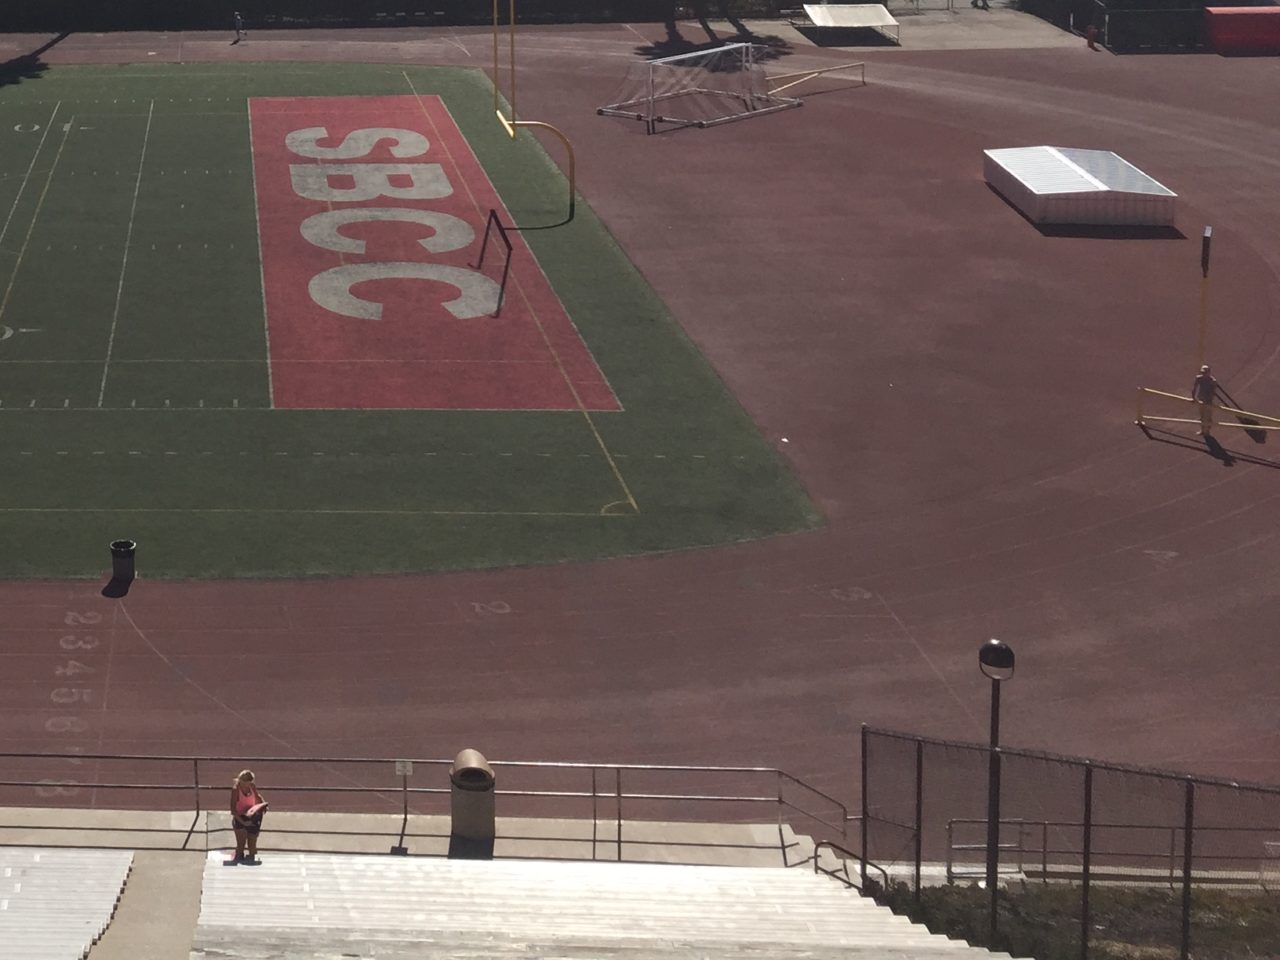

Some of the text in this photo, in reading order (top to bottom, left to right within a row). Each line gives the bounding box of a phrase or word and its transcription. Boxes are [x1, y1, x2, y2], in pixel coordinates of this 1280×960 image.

[285, 127, 505, 320] SBCC
[64, 611, 102, 625] 2
[59, 635, 99, 650] 3
[55, 660, 95, 676] 4
[50, 688, 93, 704] 5
